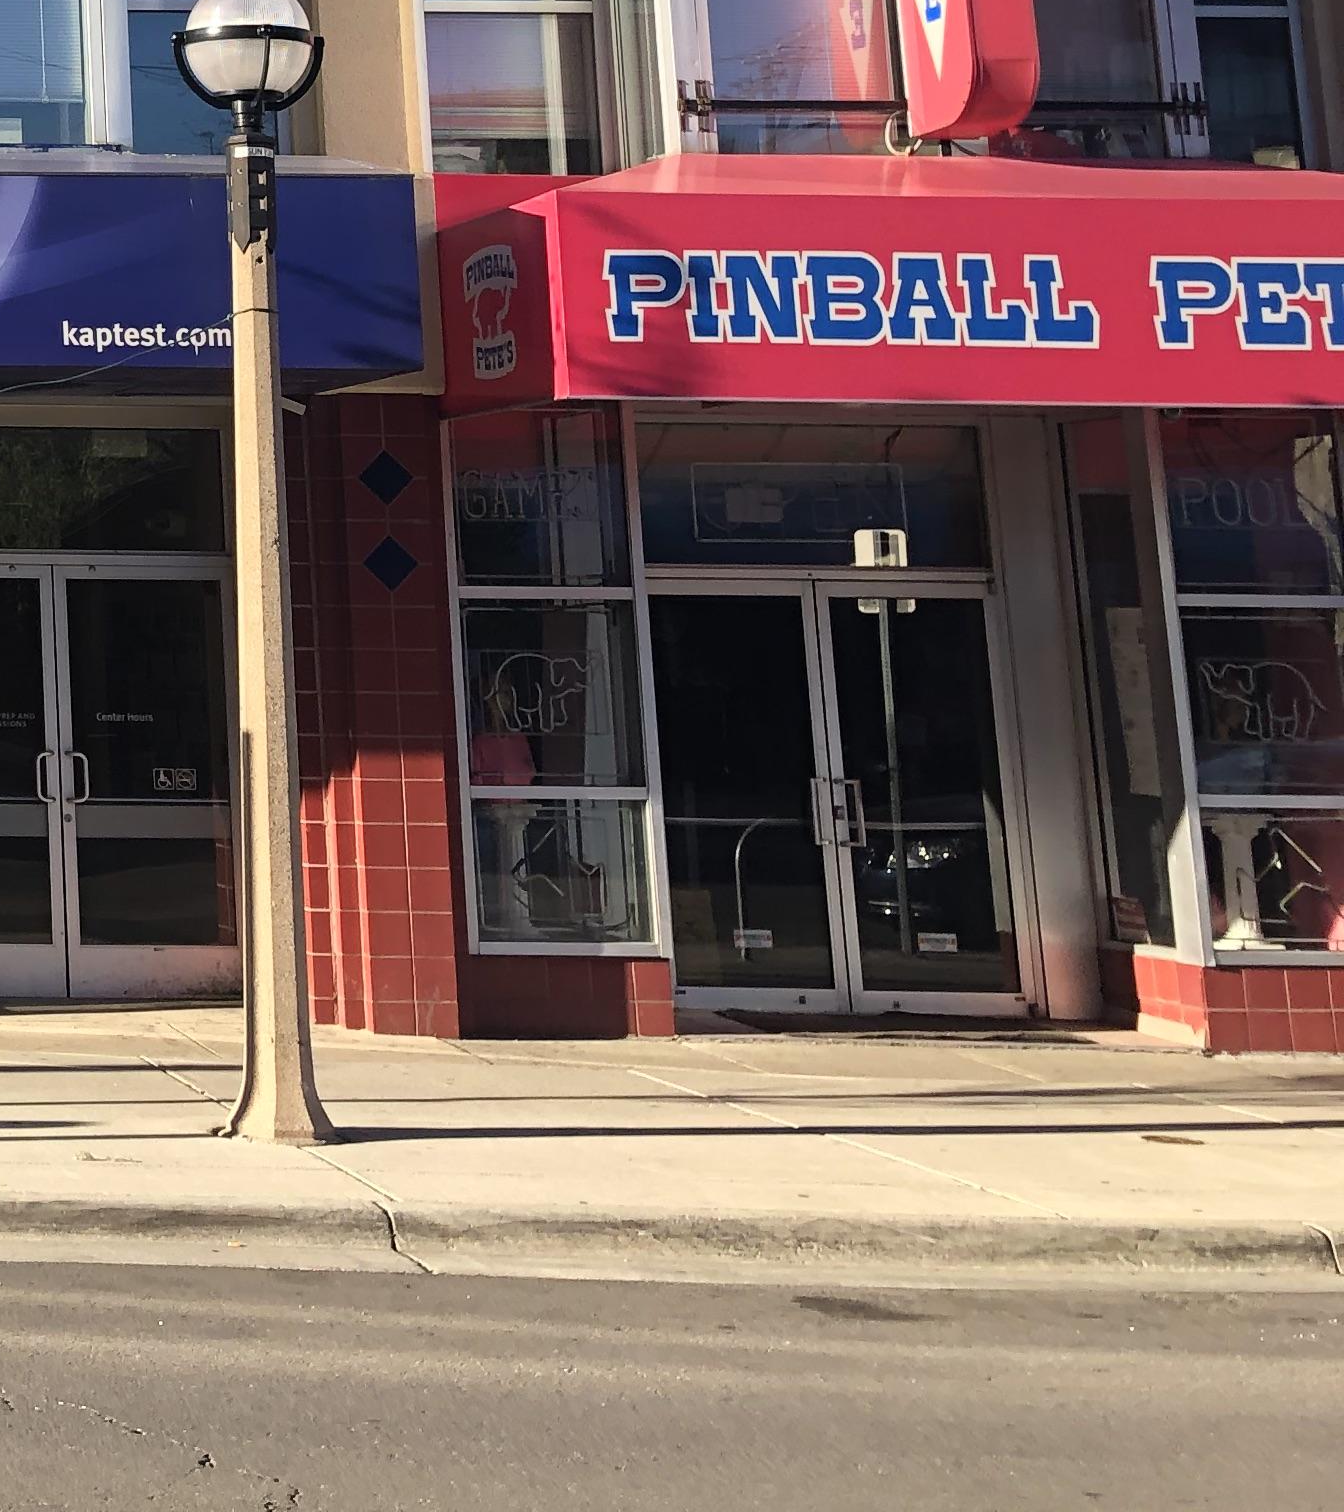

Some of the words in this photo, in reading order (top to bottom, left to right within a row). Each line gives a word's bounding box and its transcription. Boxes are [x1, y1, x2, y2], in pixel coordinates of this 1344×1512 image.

[465, 253, 515, 291] PINBALL
[603, 250, 1100, 349] PINBALL
[62, 319, 232, 353] kaptest.com
[96, 712, 126, 722] Center
[127, 712, 154, 723] Hours
